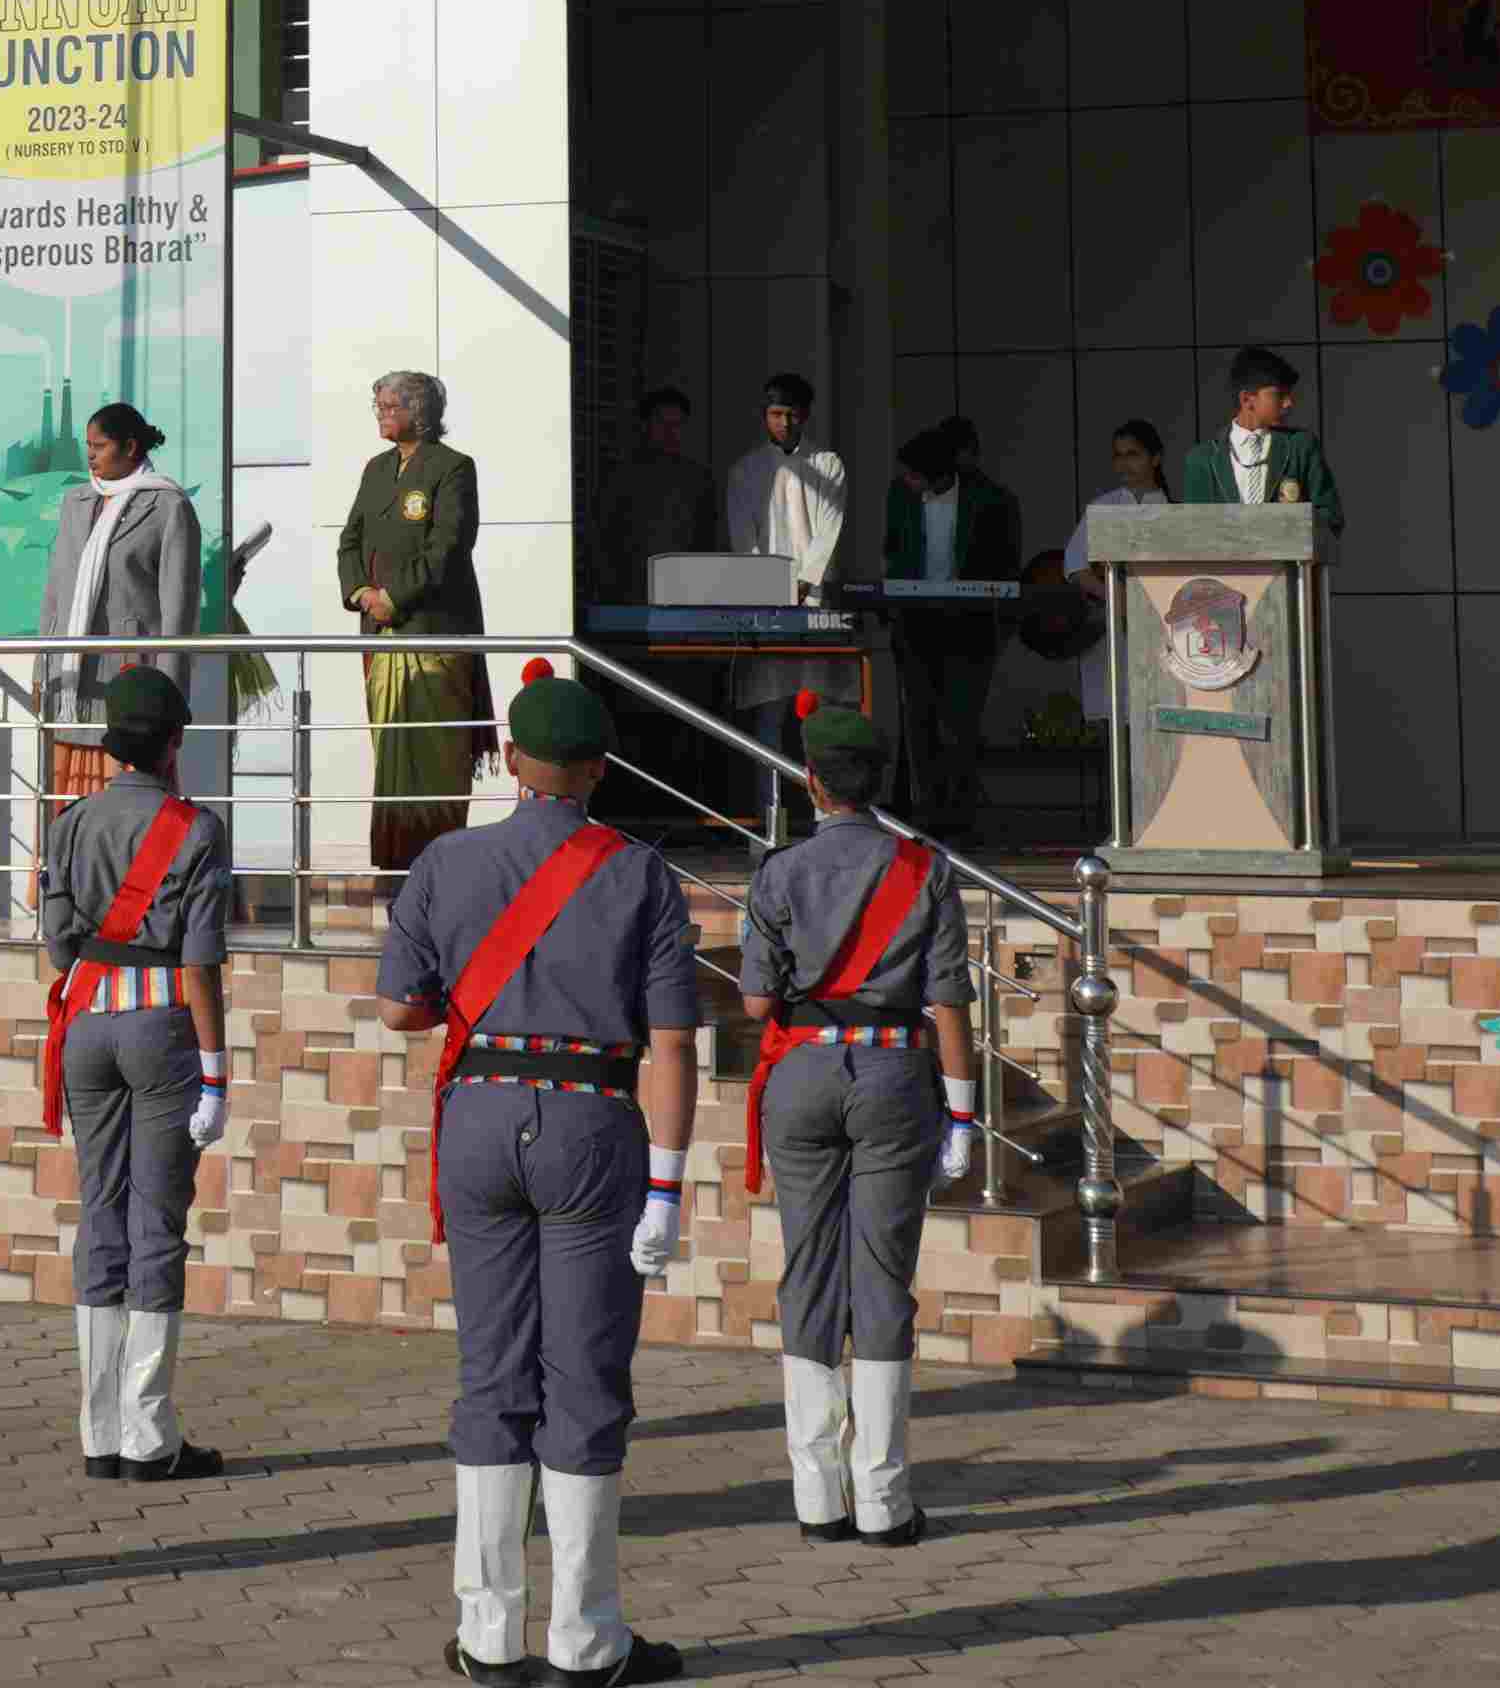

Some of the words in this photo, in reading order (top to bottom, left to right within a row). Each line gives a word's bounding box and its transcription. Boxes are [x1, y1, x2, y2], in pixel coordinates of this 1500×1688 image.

[27, 103, 128, 133] 2023-24
[14, 141, 75, 158] NURSERY
[78, 140, 96, 156] TO
[76, 196, 179, 230] Healthy
[188, 193, 209, 224] &
